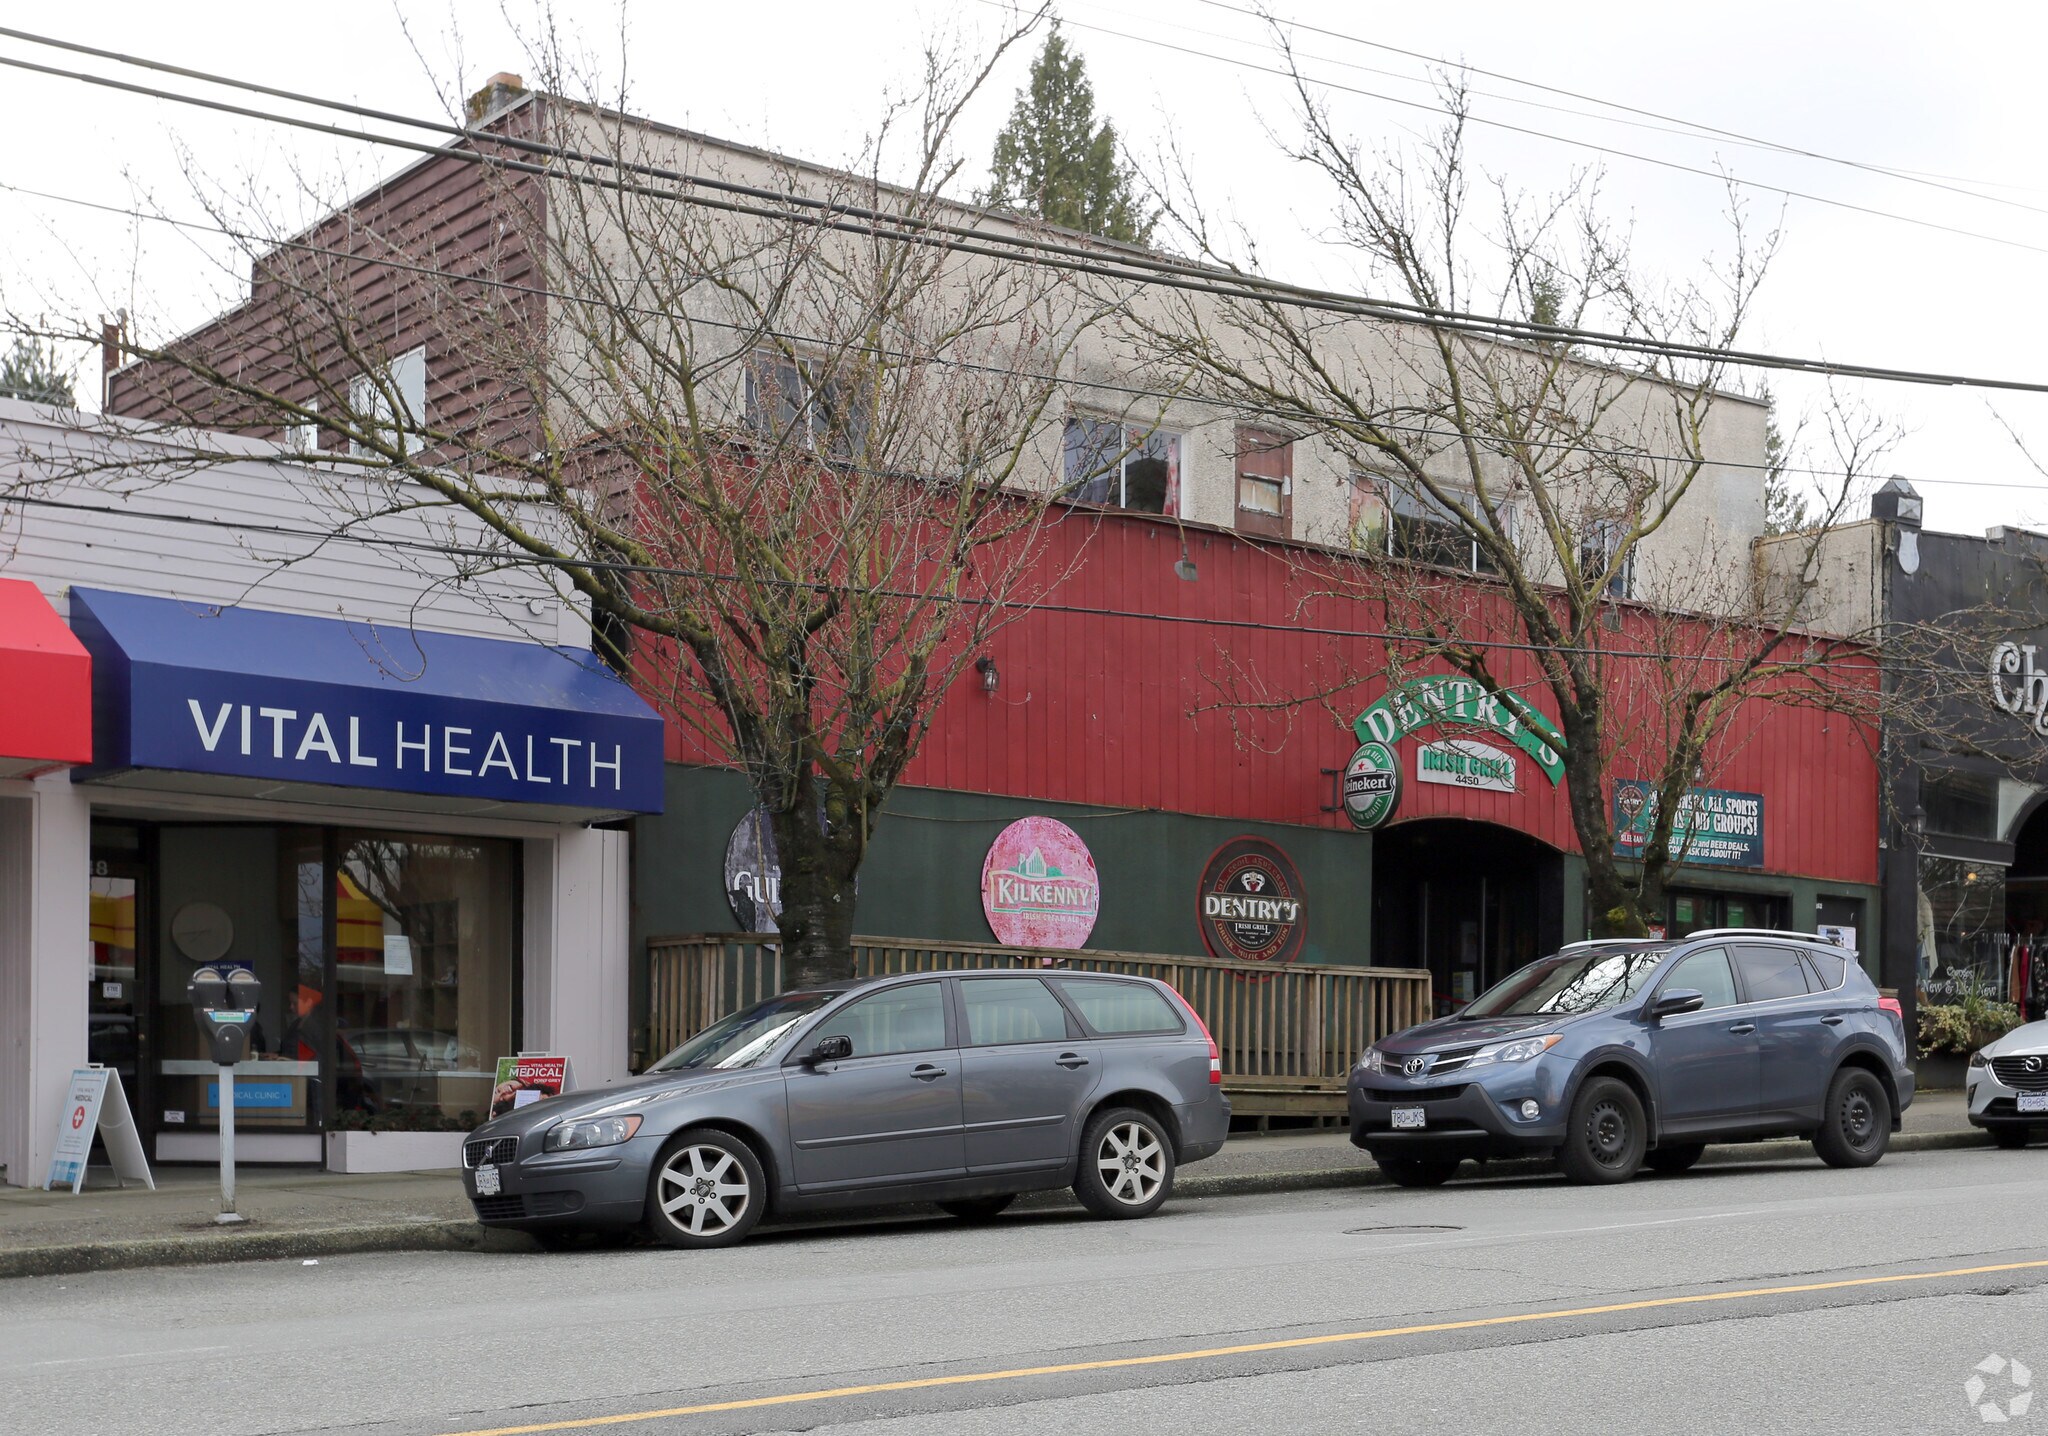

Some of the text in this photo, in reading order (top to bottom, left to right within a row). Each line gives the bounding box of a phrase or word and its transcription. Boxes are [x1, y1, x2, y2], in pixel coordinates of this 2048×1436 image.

[187, 698, 621, 790] VITAL HEALTH
[1423, 750, 1466, 775] IRISH
[1455, 775, 1479, 786] 4450
[1365, 797, 1383, 819] QUALITY
[1707, 795, 1724, 813] ALL
[1725, 797, 1758, 816] SPORTS
[1713, 815, 1758, 836] GROUPS!
[1687, 847, 1700, 856] ASK
[1700, 848, 1710, 857] US
[1709, 850, 1732, 859] ABOUT
[1732, 851, 1741, 860] IT!
[1698, 840, 1709, 849] and
[1710, 842, 1727, 850] BEER
[1727, 843, 1750, 852] DEALS.
[998, 878, 1089, 906] KILKENNY
[1205, 896, 1299, 921] DENTRY'S
[1234, 922, 1251, 932] IRISH
[1237, 949, 1259, 960] MUSIC
[1263, 945, 1277, 958] AND
[1278, 927, 1289, 946] FUN
[1921, 979, 1942, 993] New
[1945, 981, 1954, 994] &
[509, 1067, 562, 1077] MEDICAL
[75, 1094, 92, 1102] MEDICAL
[233, 1091, 280, 1099] DICAL CLINIC
